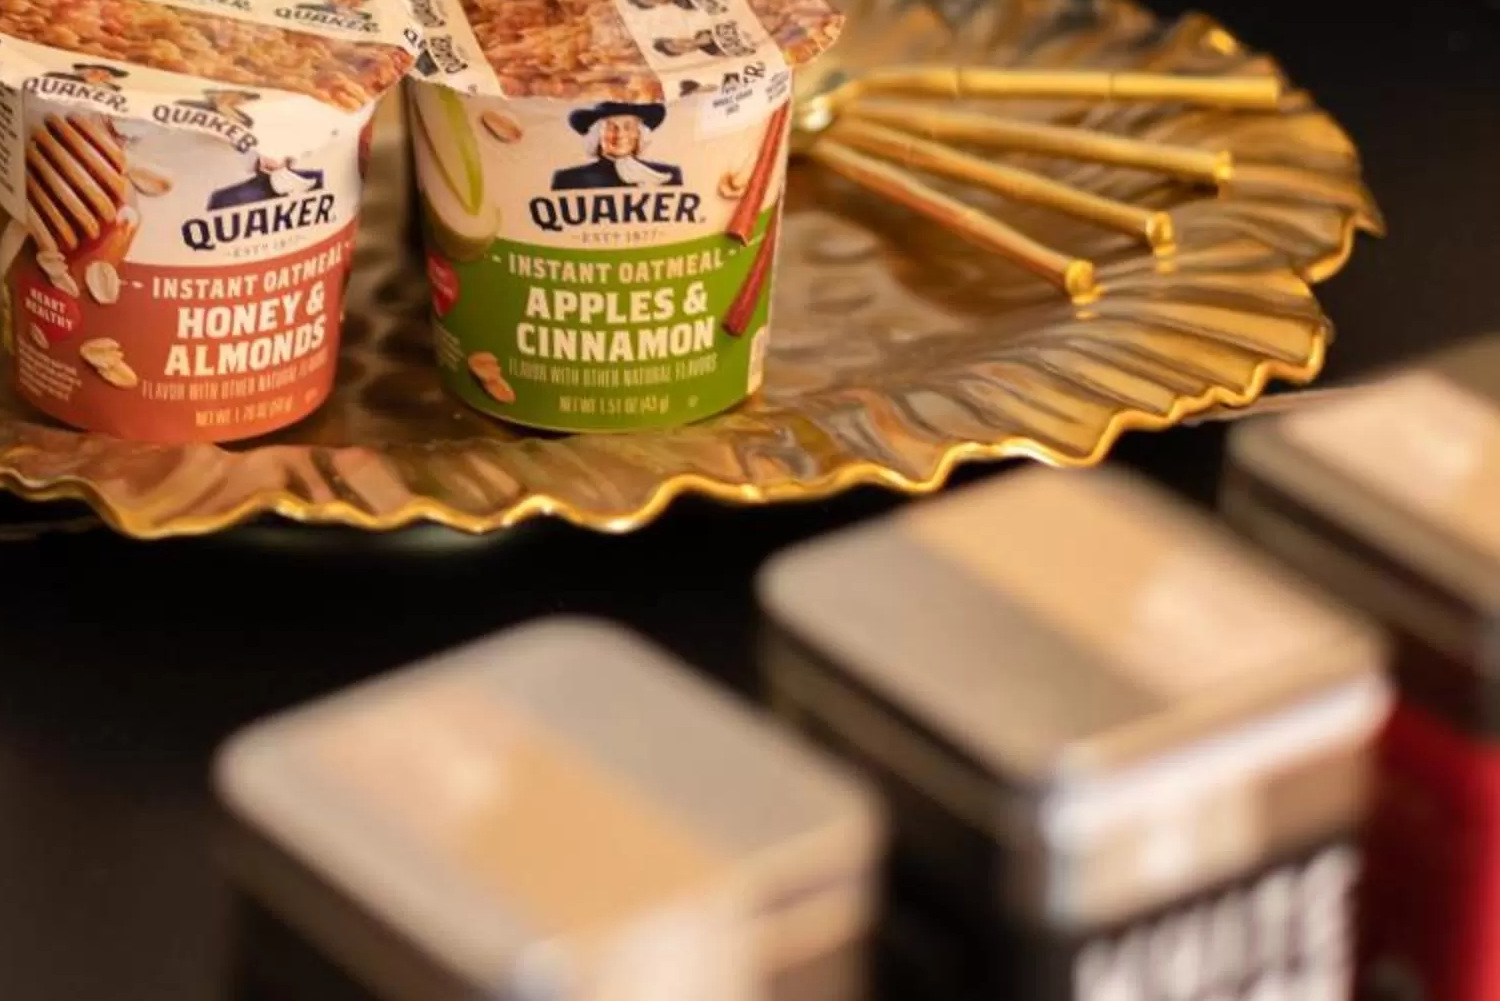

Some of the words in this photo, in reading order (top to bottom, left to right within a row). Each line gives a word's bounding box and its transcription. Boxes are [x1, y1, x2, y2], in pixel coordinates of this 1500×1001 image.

[273, 5, 377, 33] QUAKER
[23, 76, 127, 112] QUAKER
[181, 194, 336, 251] QUAKER
[529, 191, 702, 232] QUAKER
[153, 274, 259, 300] INSTANT
[264, 243, 342, 291] OATMEAL
[508, 251, 613, 284] INSTANT
[618, 248, 725, 285] OATMEAL
[177, 291, 302, 340] HONEY
[306, 281, 326, 317] &
[526, 284, 676, 325] APPLES
[682, 280, 709, 316] &
[164, 314, 327, 377] ALMONDS
[516, 316, 717, 363] CINNAMON
